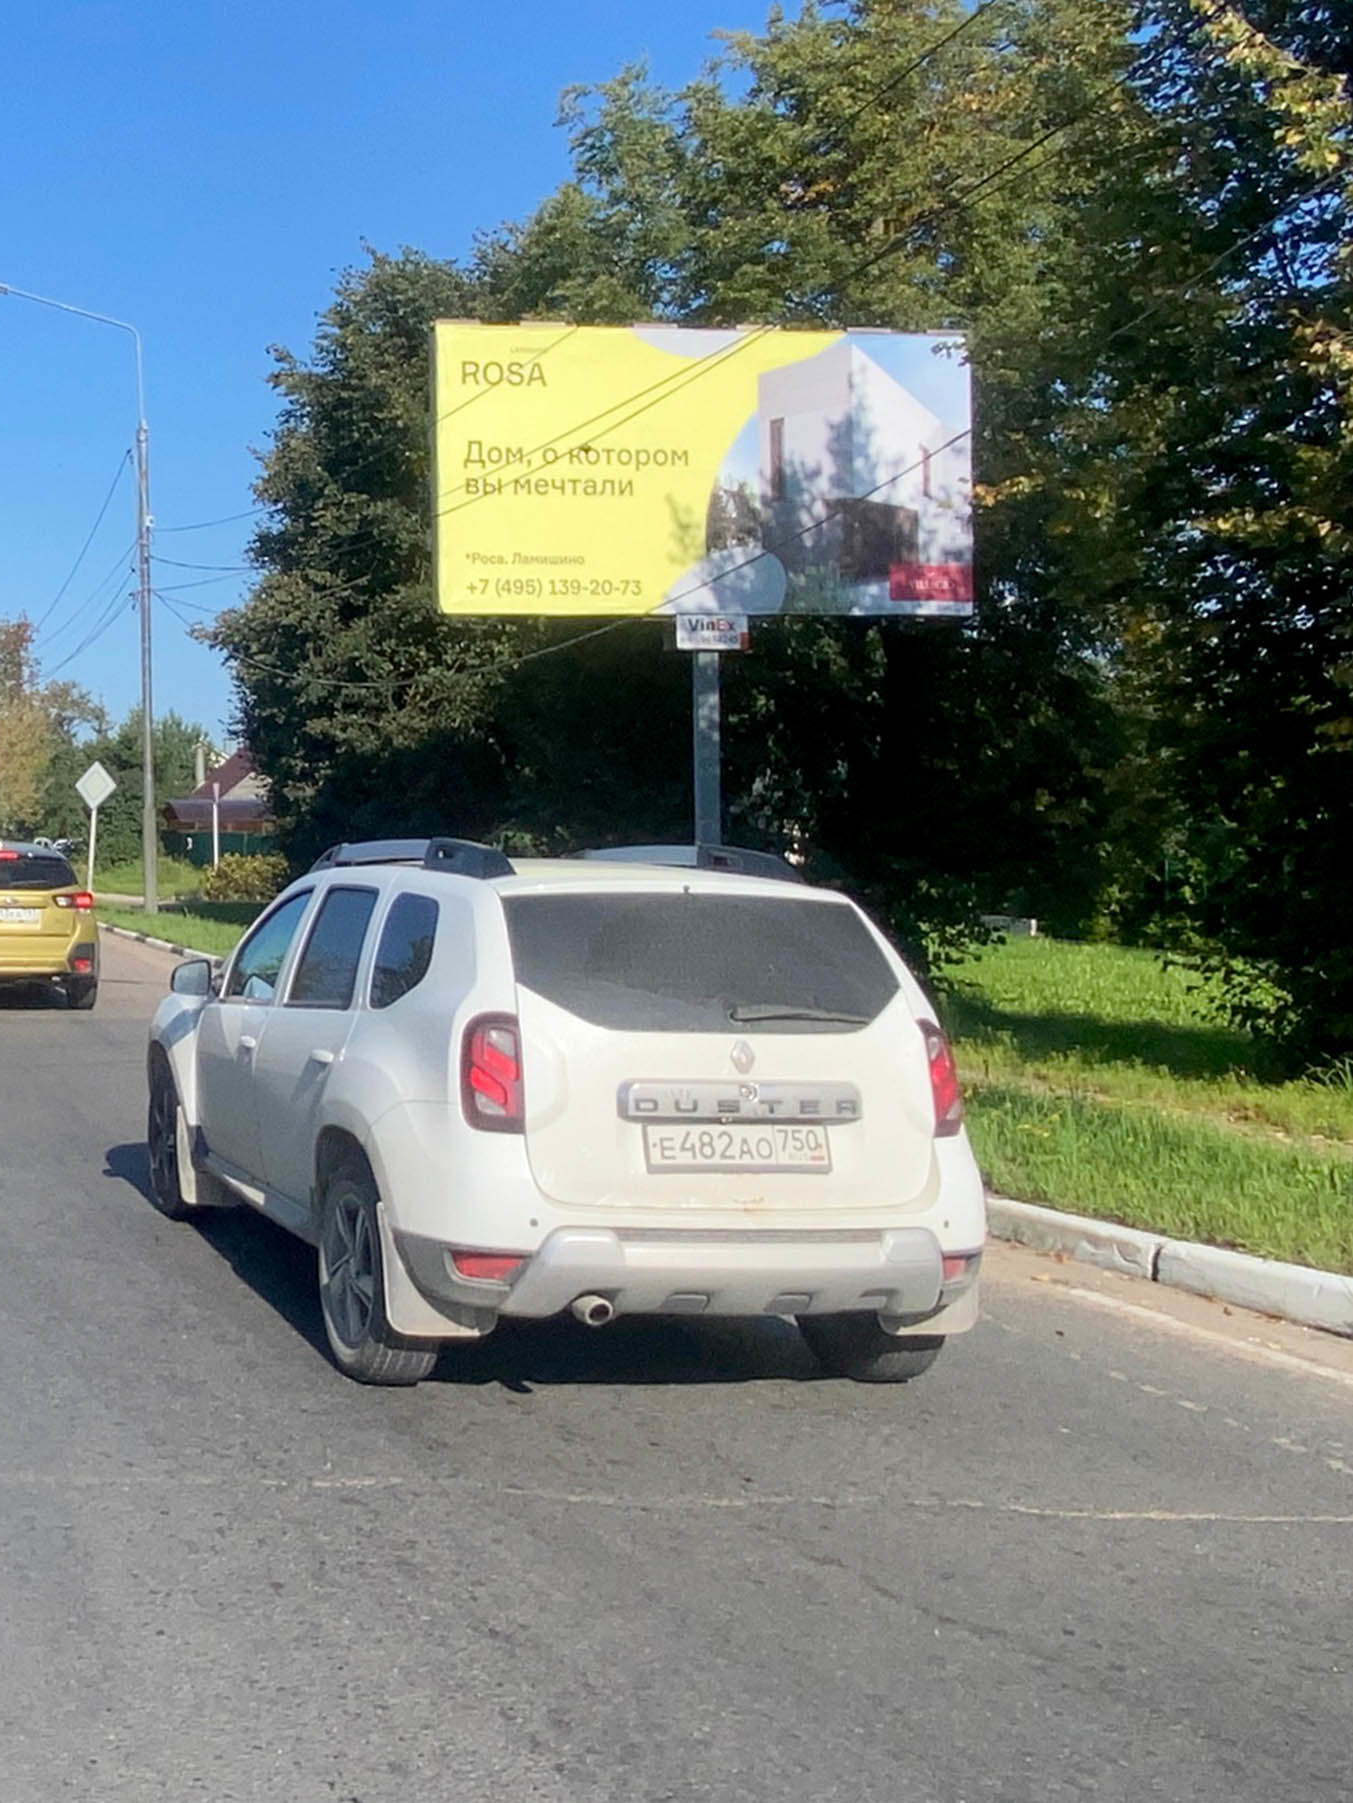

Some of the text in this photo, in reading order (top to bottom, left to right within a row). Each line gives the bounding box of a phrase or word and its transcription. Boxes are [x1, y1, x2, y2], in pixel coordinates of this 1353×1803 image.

[461, 359, 547, 387] ROSA
[463, 439, 689, 471] Дом, о котором
[465, 477, 634, 496] вы мечтали
[511, 552, 585, 566] Ламишино
[466, 578, 642, 598] +7 (495) 139-20-73
[634, 1098, 857, 1115] DUSTER
[659, 1129, 819, 1160] Е482АО 750
